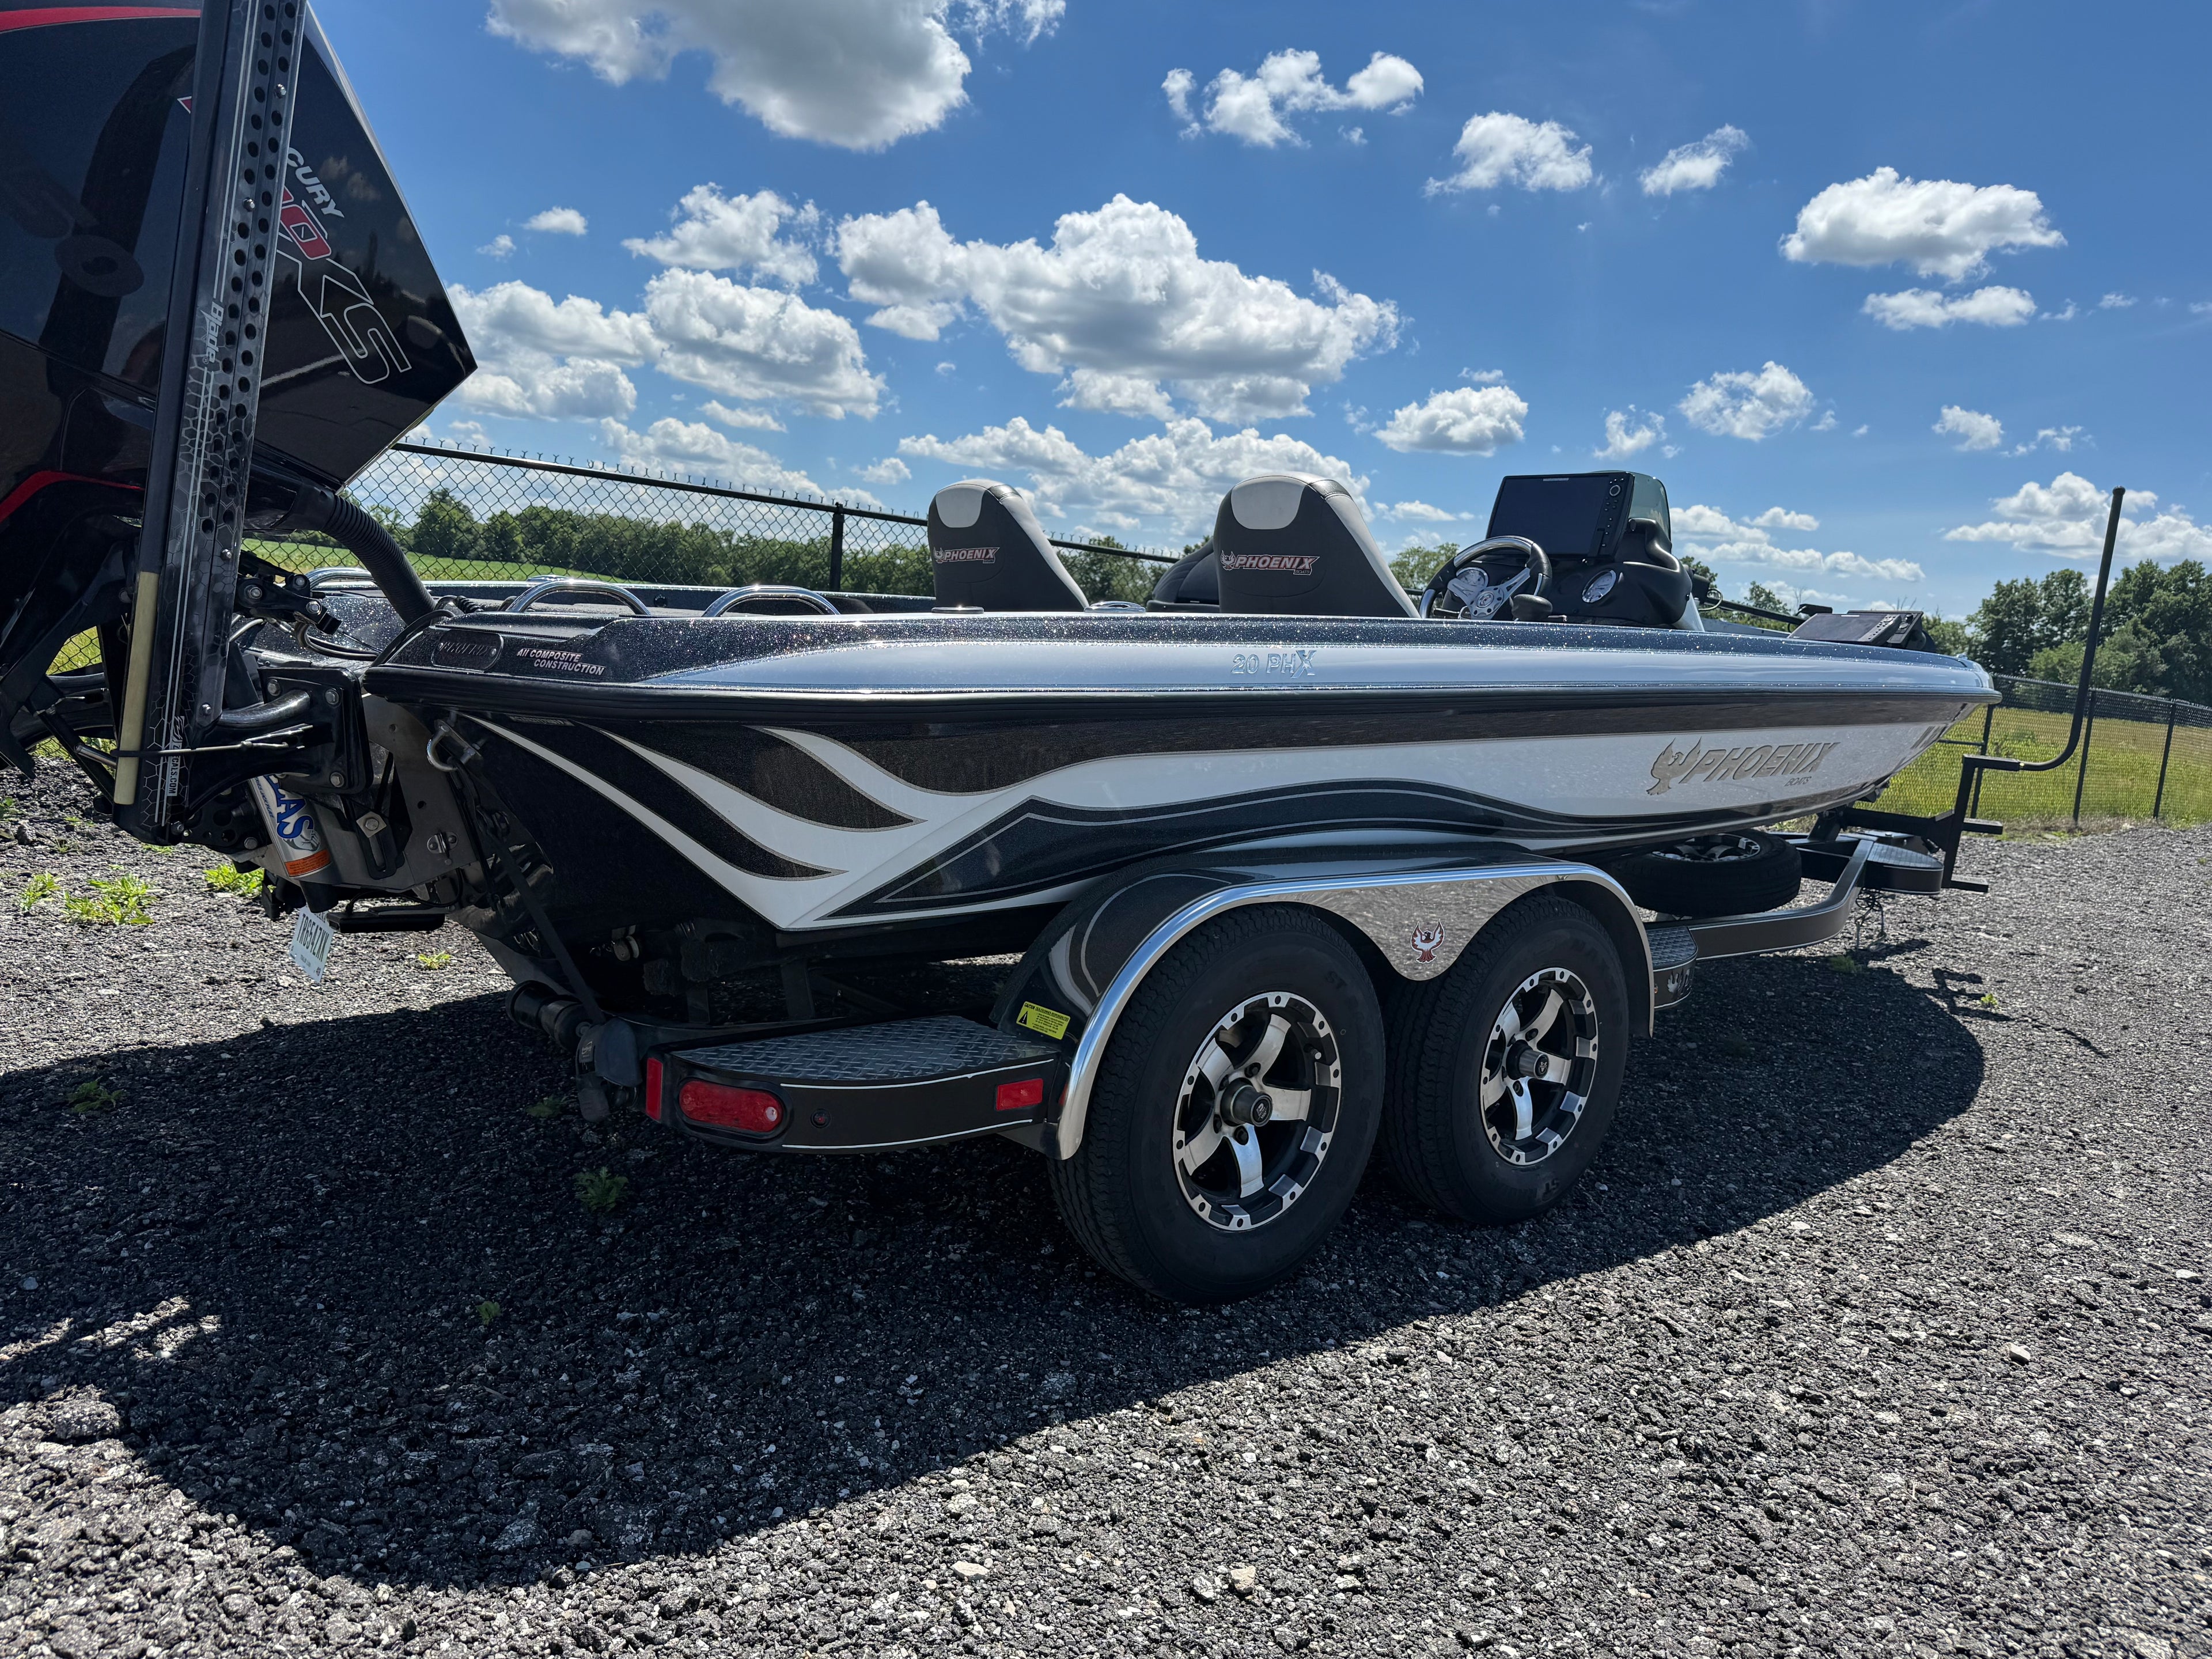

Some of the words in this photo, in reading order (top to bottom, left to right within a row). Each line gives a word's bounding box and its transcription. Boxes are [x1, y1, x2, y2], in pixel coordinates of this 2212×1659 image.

[944, 548, 998, 561] PHOENIX
[1234, 555, 1317, 569] PHOENIX
[529, 649, 582, 662] COMPOSITE
[533, 658, 605, 676] CONSTRUCTION
[1230, 654, 1260, 674] 20
[1266, 649, 1317, 679] PHX
[1678, 741, 1842, 784] PHOENIX
[1783, 777, 1812, 787] BOATS
